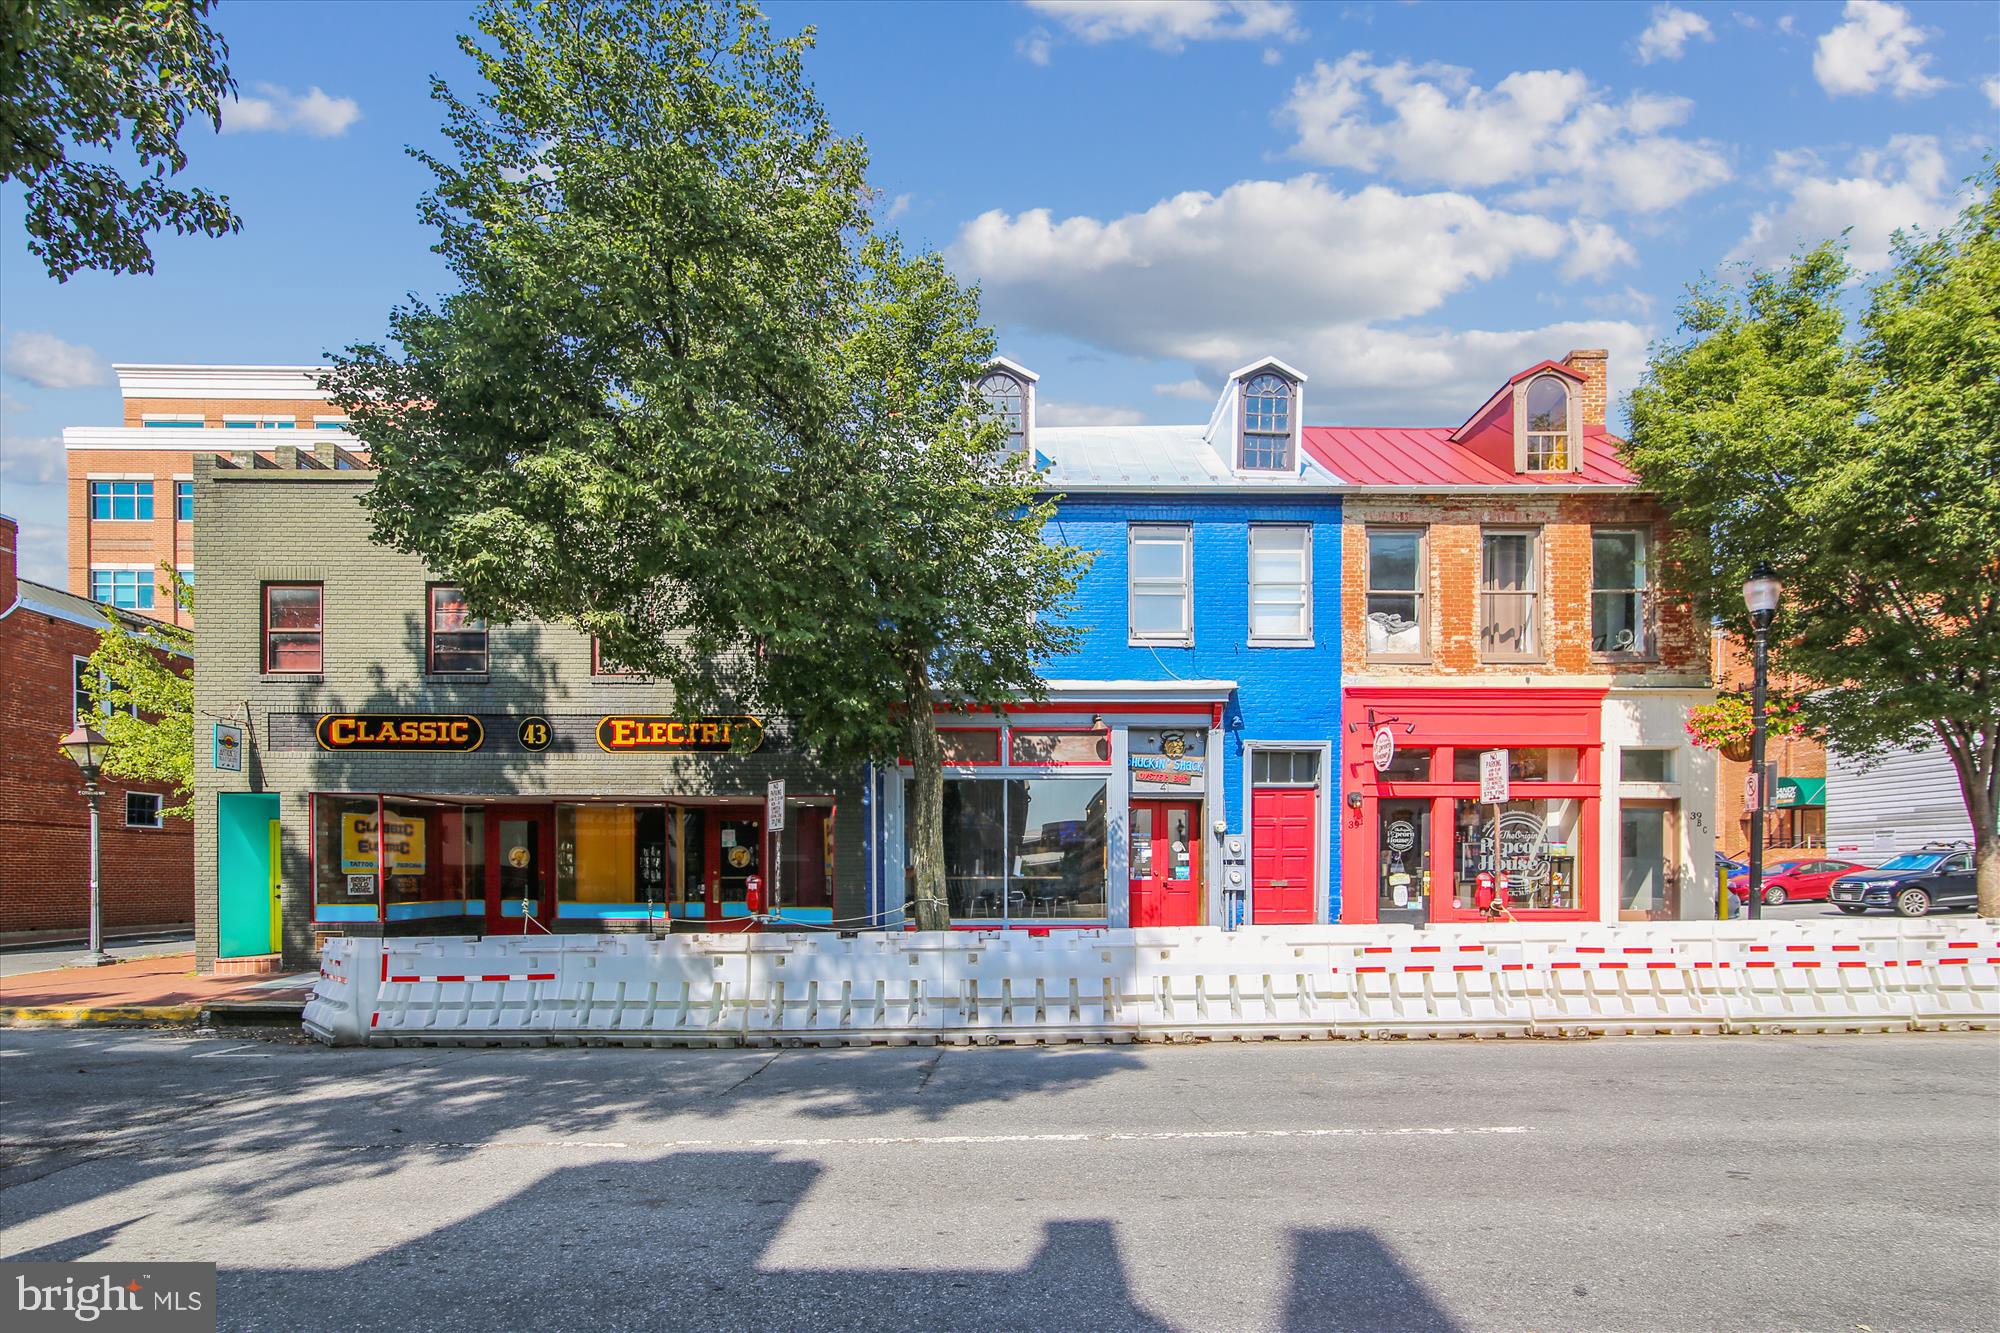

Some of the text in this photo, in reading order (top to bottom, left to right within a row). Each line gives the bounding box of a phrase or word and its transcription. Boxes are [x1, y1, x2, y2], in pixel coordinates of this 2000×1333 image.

[329, 719, 469, 745] CLASSIC
[523, 724, 547, 744] 43
[1490, 752, 1498, 760] NO
[1138, 771, 1169, 781] OYSTER
[1690, 811, 1702, 820] 39
[1697, 819, 1702, 827] B
[1702, 826, 1708, 834] C
